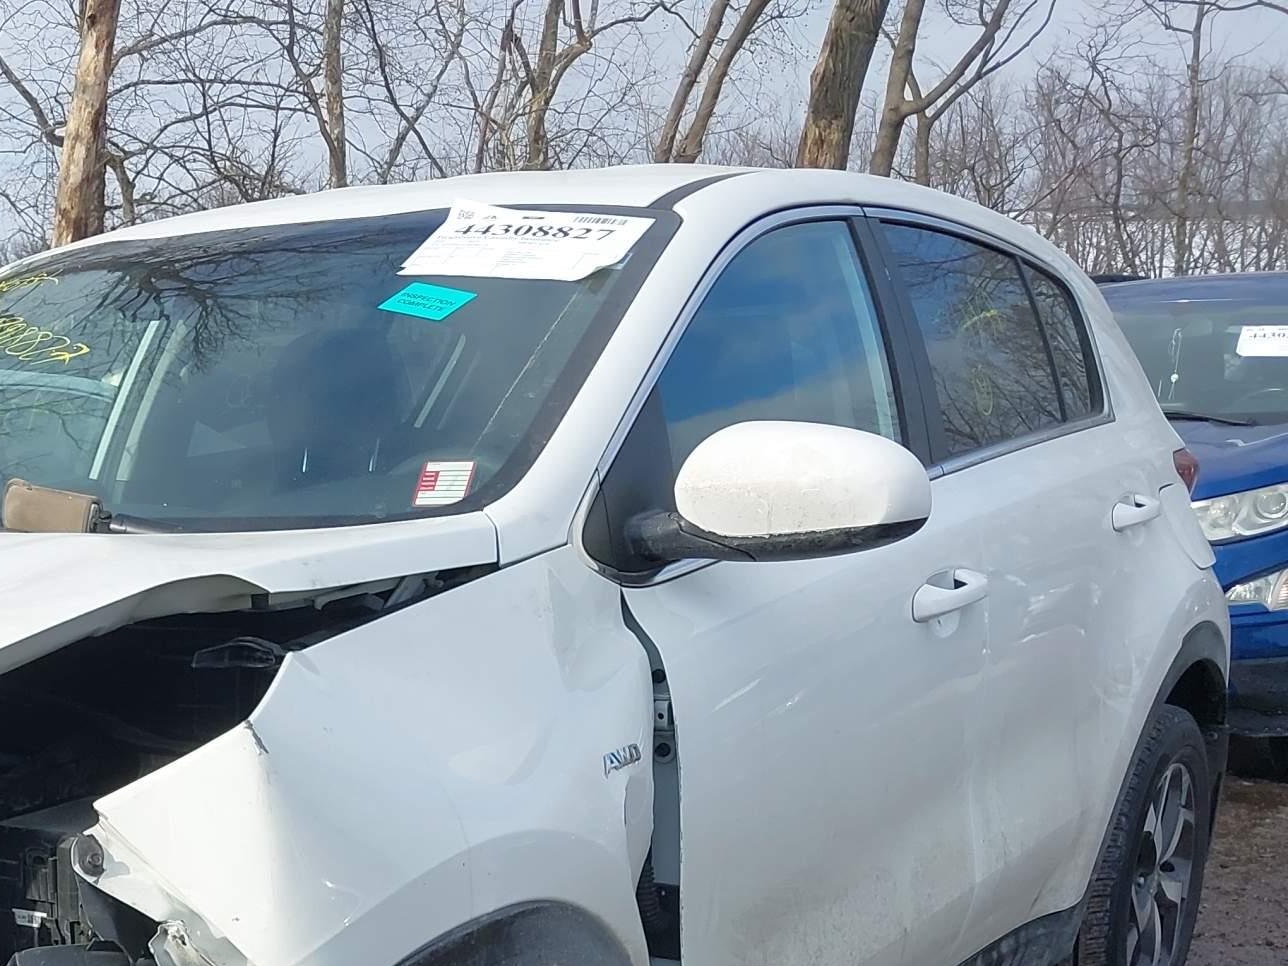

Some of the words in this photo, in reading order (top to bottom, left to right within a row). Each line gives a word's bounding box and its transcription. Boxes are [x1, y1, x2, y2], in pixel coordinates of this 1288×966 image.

[454, 222, 617, 241] 44308827
[397, 298, 443, 312] COMPLETE
[400, 292, 457, 306] INSPECTION
[602, 743, 642, 780] AWD
